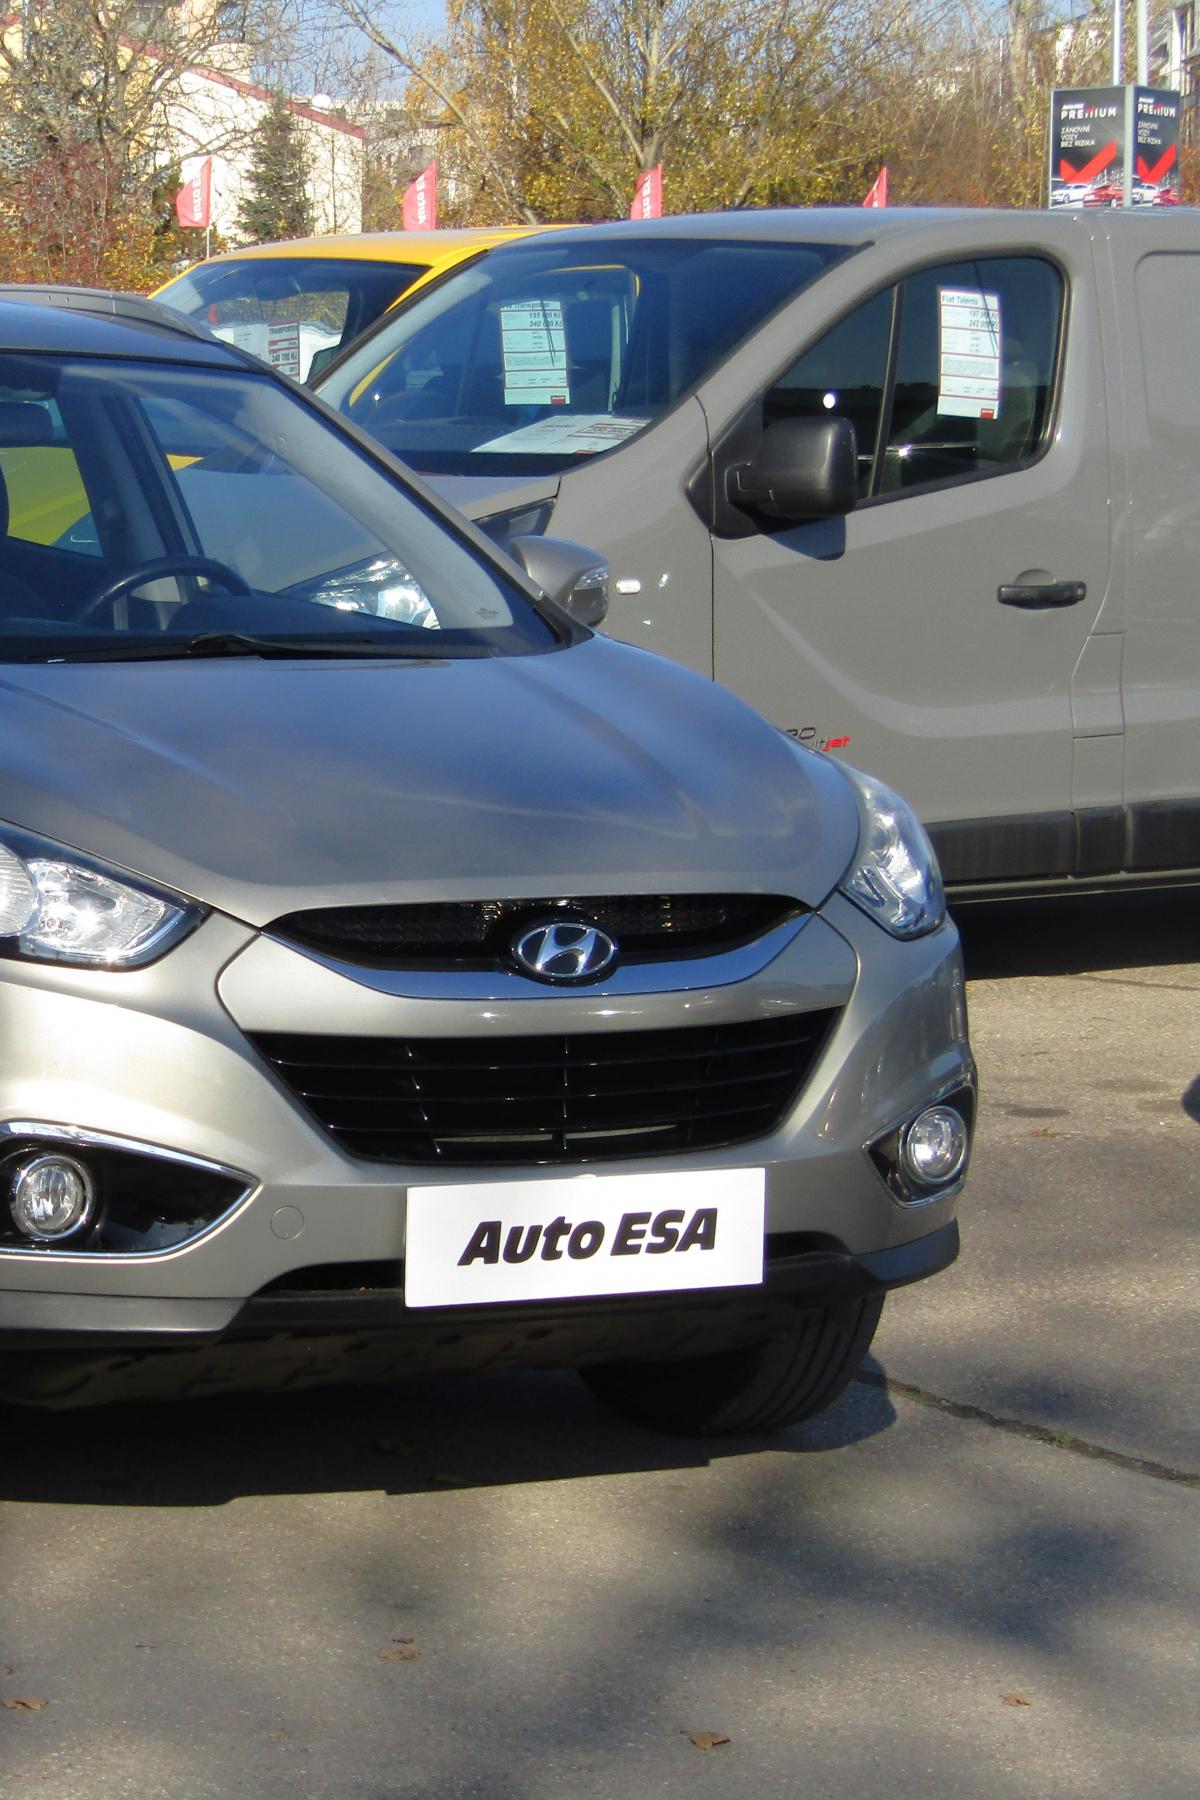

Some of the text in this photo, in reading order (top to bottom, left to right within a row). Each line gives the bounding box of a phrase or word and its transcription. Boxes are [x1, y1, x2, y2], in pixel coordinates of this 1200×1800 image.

[1061, 106, 1117, 120] PREMIUM
[457, 1208, 718, 1267] Auto ESA
